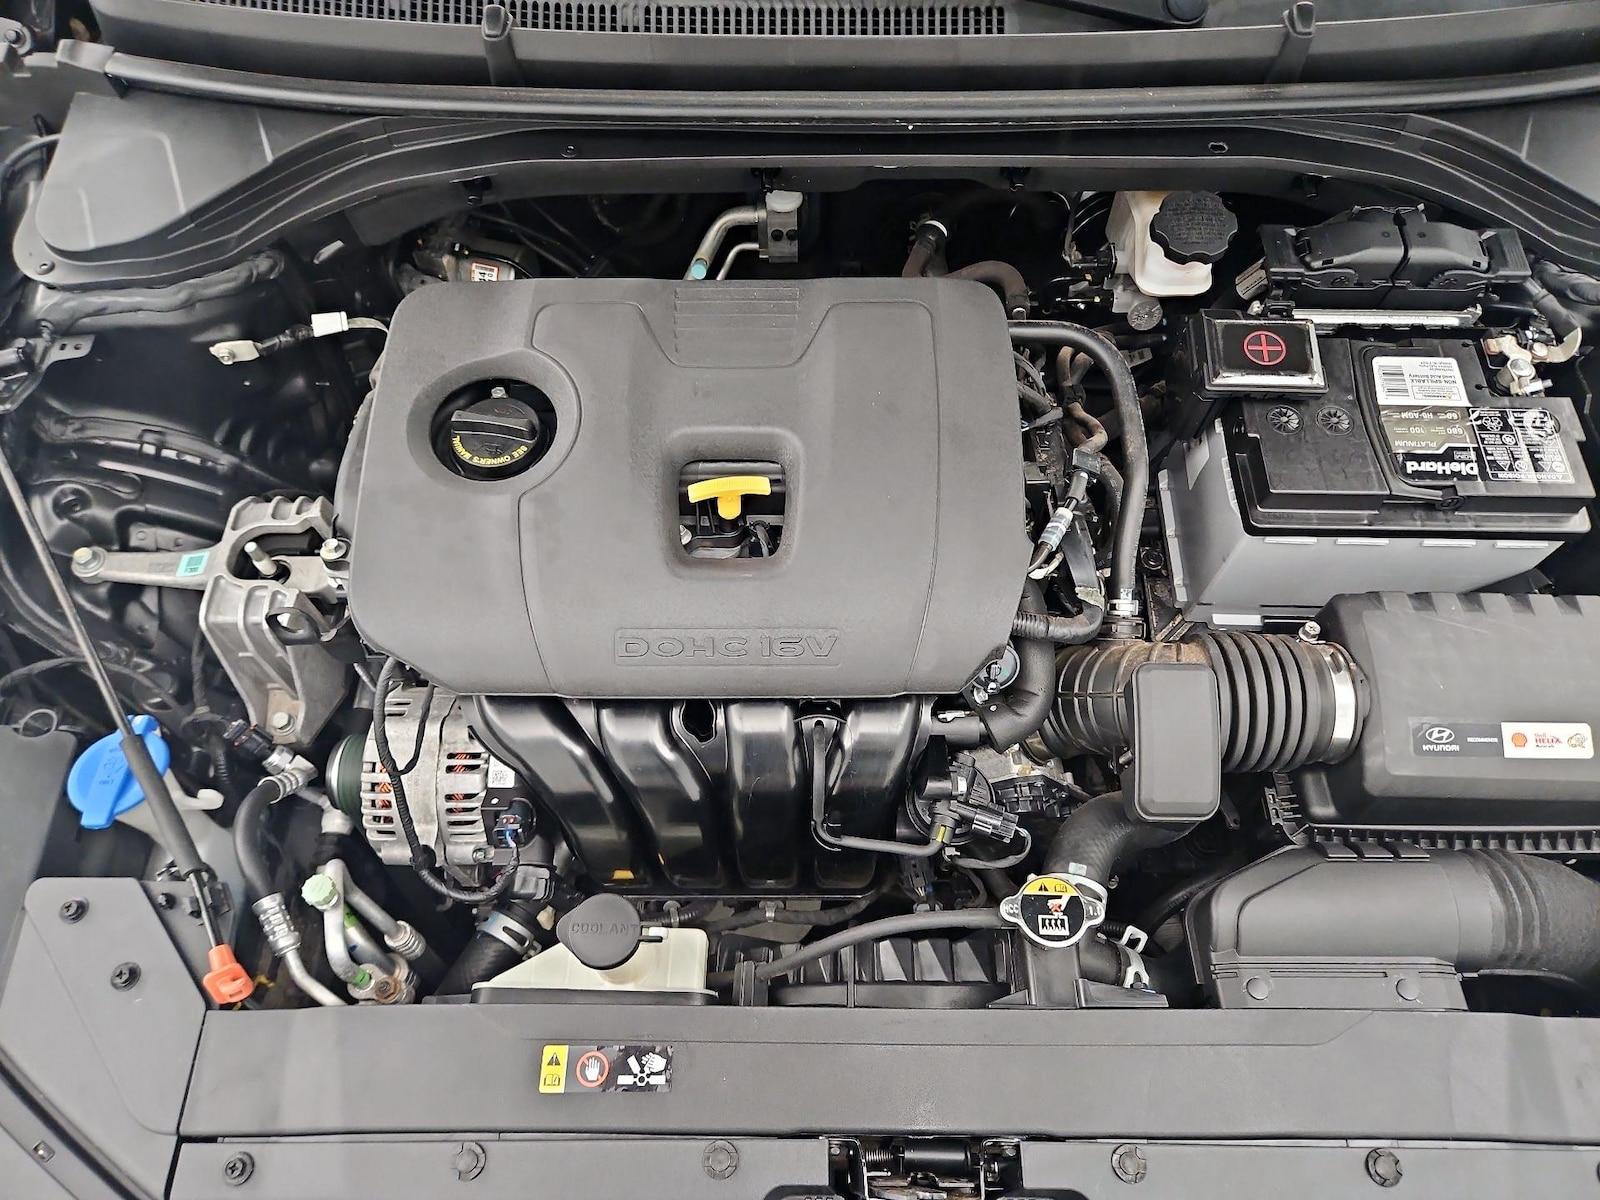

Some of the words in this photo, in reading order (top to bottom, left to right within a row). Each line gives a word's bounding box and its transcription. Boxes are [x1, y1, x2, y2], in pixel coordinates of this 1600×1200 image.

[1410, 426, 1426, 434] 100
[452, 435, 472, 460] MANUAL
[1395, 439, 1437, 447] PLATINUM
[511, 445, 528, 458] SEE
[471, 455, 511, 465] OWNER'S
[1405, 460, 1479, 476] DieHard
[617, 636, 748, 658] DOHC
[760, 636, 838, 658] 16V
[1535, 736, 1563, 745] HELIX
[1422, 744, 1460, 752] HYUNDAI
[1003, 903, 1019, 914] HCC
[1088, 905, 1101, 917] 1.1
[571, 922, 640, 935] COOLANT
